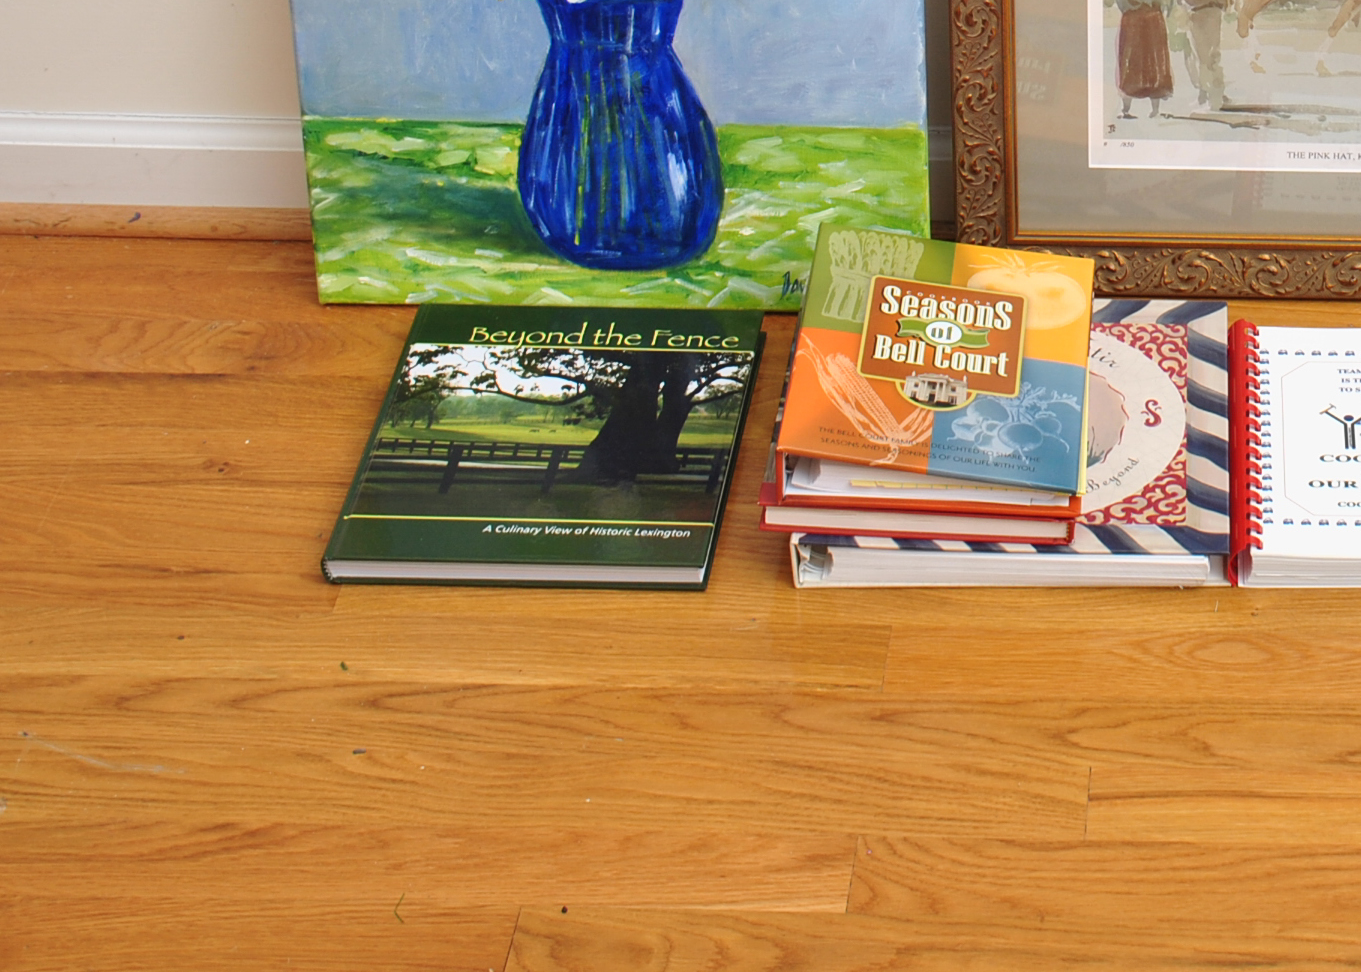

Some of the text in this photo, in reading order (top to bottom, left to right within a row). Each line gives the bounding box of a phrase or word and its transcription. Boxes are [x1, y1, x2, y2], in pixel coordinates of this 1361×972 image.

[1286, 151, 1306, 159] THE
[1308, 151, 1331, 160] PINK
[1333, 152, 1356, 161] HAT,
[469, 321, 740, 350] Beyond the Fence
[872, 334, 1009, 377] Bell Court
[819, 427, 834, 435] THE
[836, 429, 856, 437] BELL
[931, 443, 980, 455] DELIGHTED
[982, 449, 993, 457] TO
[820, 437, 860, 449] SEASONS
[861, 443, 881, 452] AND
[938, 453, 951, 461] OF
[952, 455, 974, 465] OUR
[991, 461, 1015, 470] WITH
[1086, 457, 1139, 493] Beyond
[1308, 479, 1358, 489] OUR
[482, 524, 691, 539] A Culinary View of Historic Lexington
